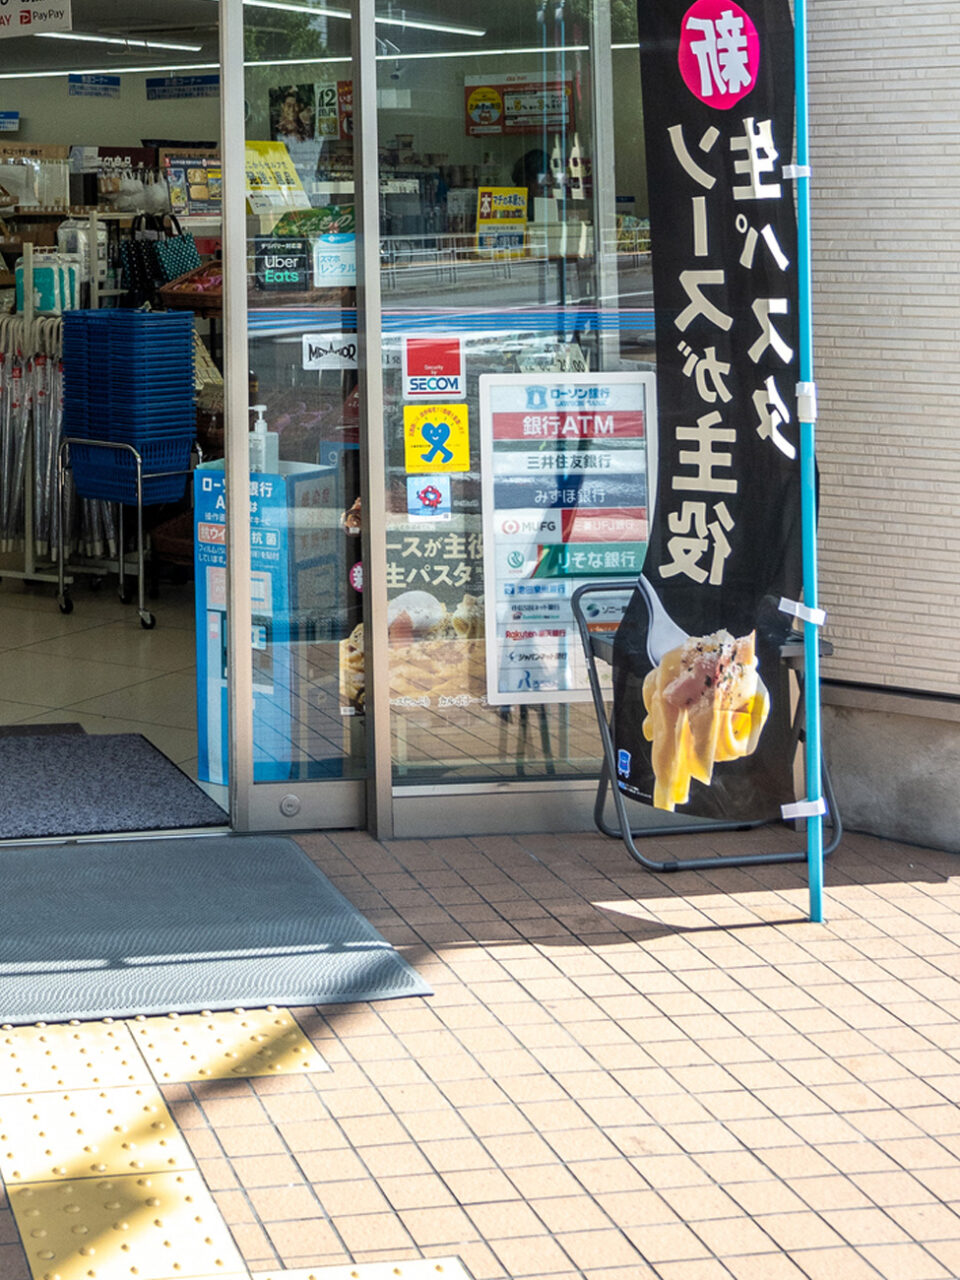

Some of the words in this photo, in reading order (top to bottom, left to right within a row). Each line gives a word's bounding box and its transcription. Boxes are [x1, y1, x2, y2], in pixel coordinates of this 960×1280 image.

[32, 9, 65, 23] PayPay
[264, 255, 300, 269] Uber
[264, 269, 300, 283] Eats
[424, 364, 444, 372] Security
[409, 377, 460, 391] SECOM
[550, 387, 610, 400] ローソン銀行
[522, 414, 614, 435] 銀行ATM
[527, 453, 612, 470] 三井住友銀行
[534, 488, 606, 504] みずほ銀行
[521, 521, 557, 532] MUFG
[251, 531, 277, 546] 抗菌
[386, 533, 484, 559] ースが主役
[558, 550, 636, 569] りそな銀行
